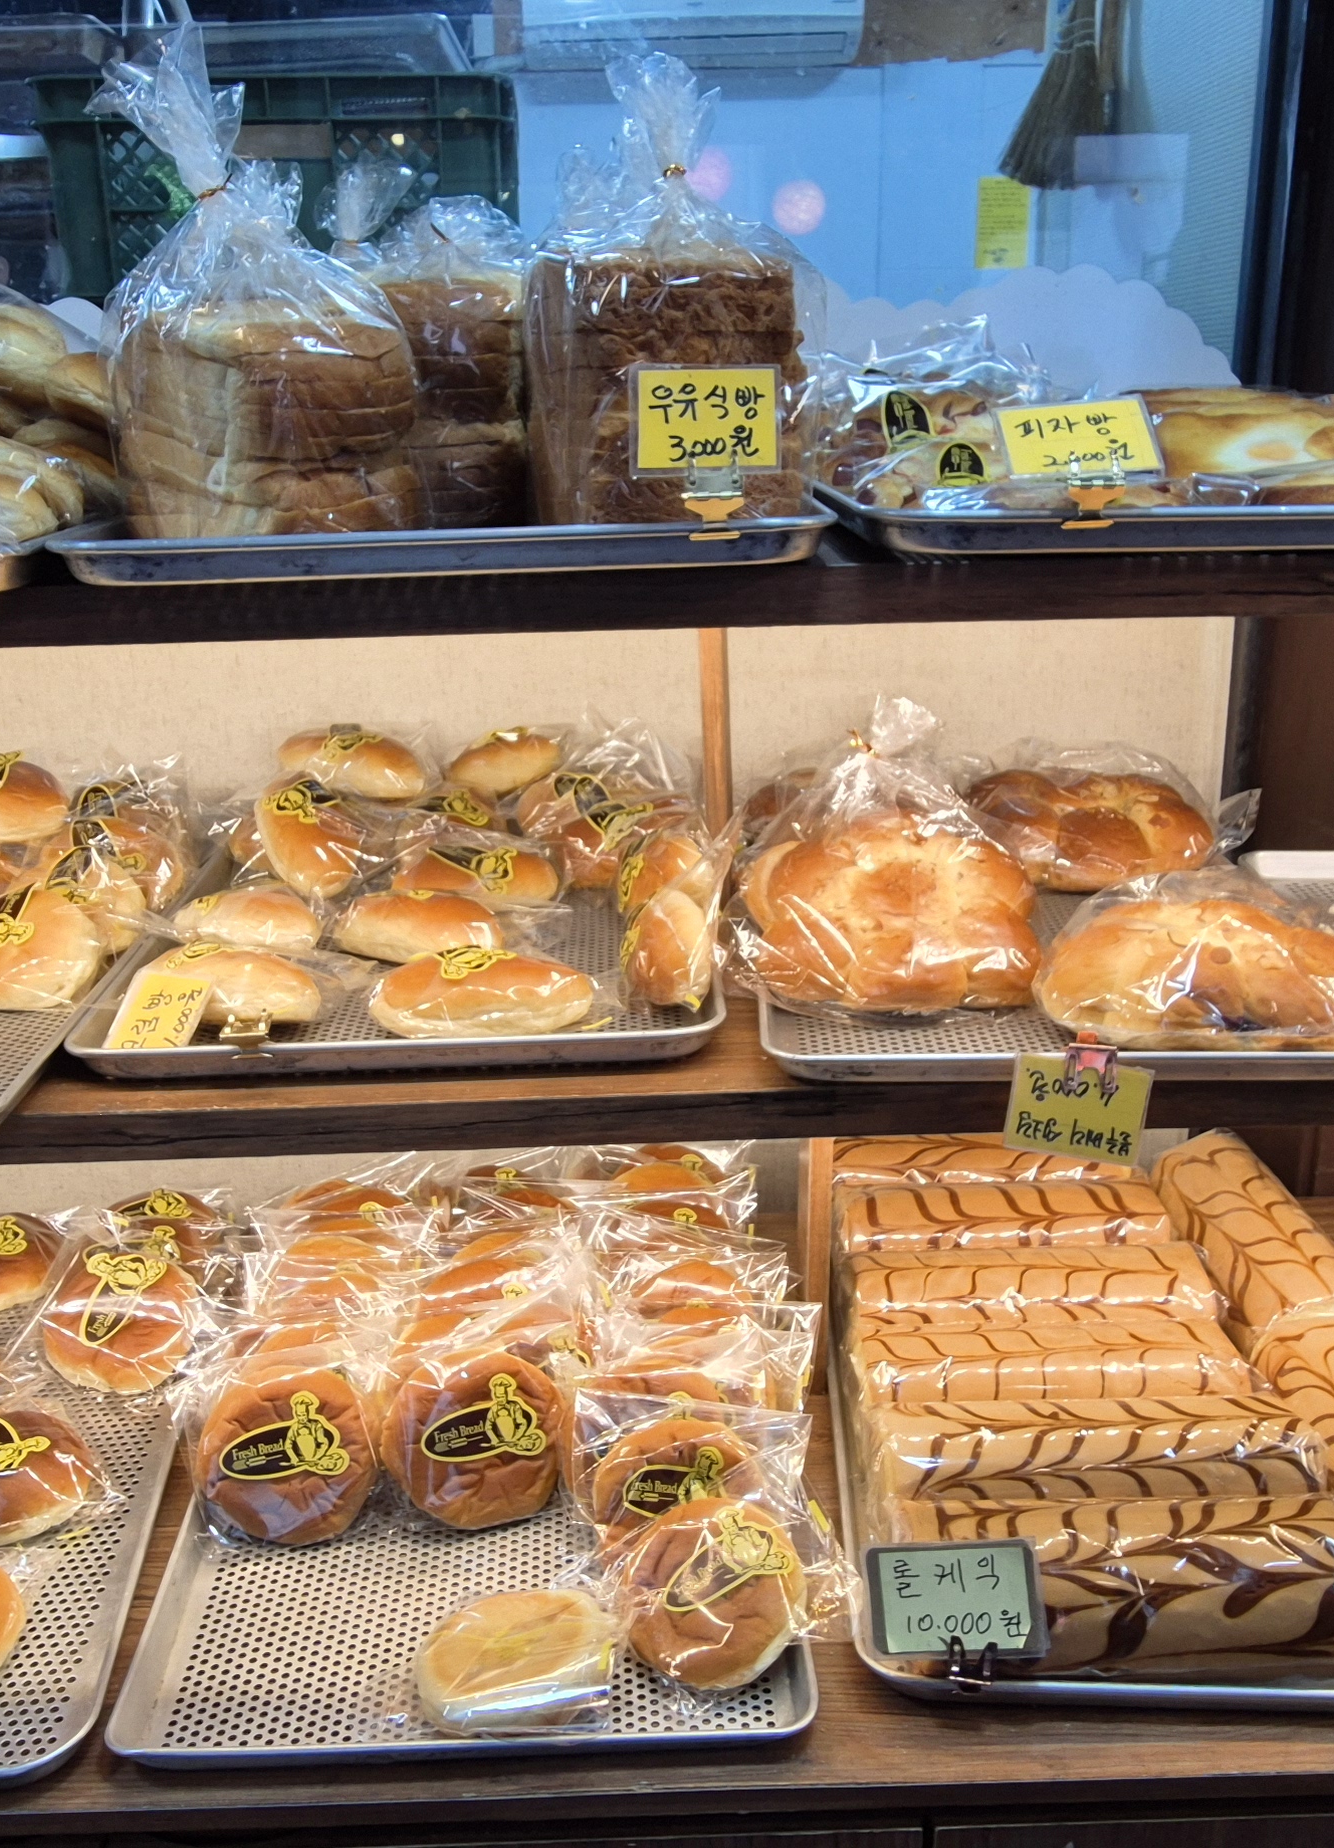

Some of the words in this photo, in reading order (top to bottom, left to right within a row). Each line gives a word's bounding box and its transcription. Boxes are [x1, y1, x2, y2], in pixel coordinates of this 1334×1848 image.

[648, 382, 766, 425] 우유식빵
[432, 1428, 459, 1443] Fresh
[459, 1420, 484, 1437] Bread
[231, 1445, 258, 1461] Fresh
[258, 1438, 284, 1455] Bread
[654, 1480, 678, 1494] Bread
[892, 1553, 1001, 1599] 롤케익
